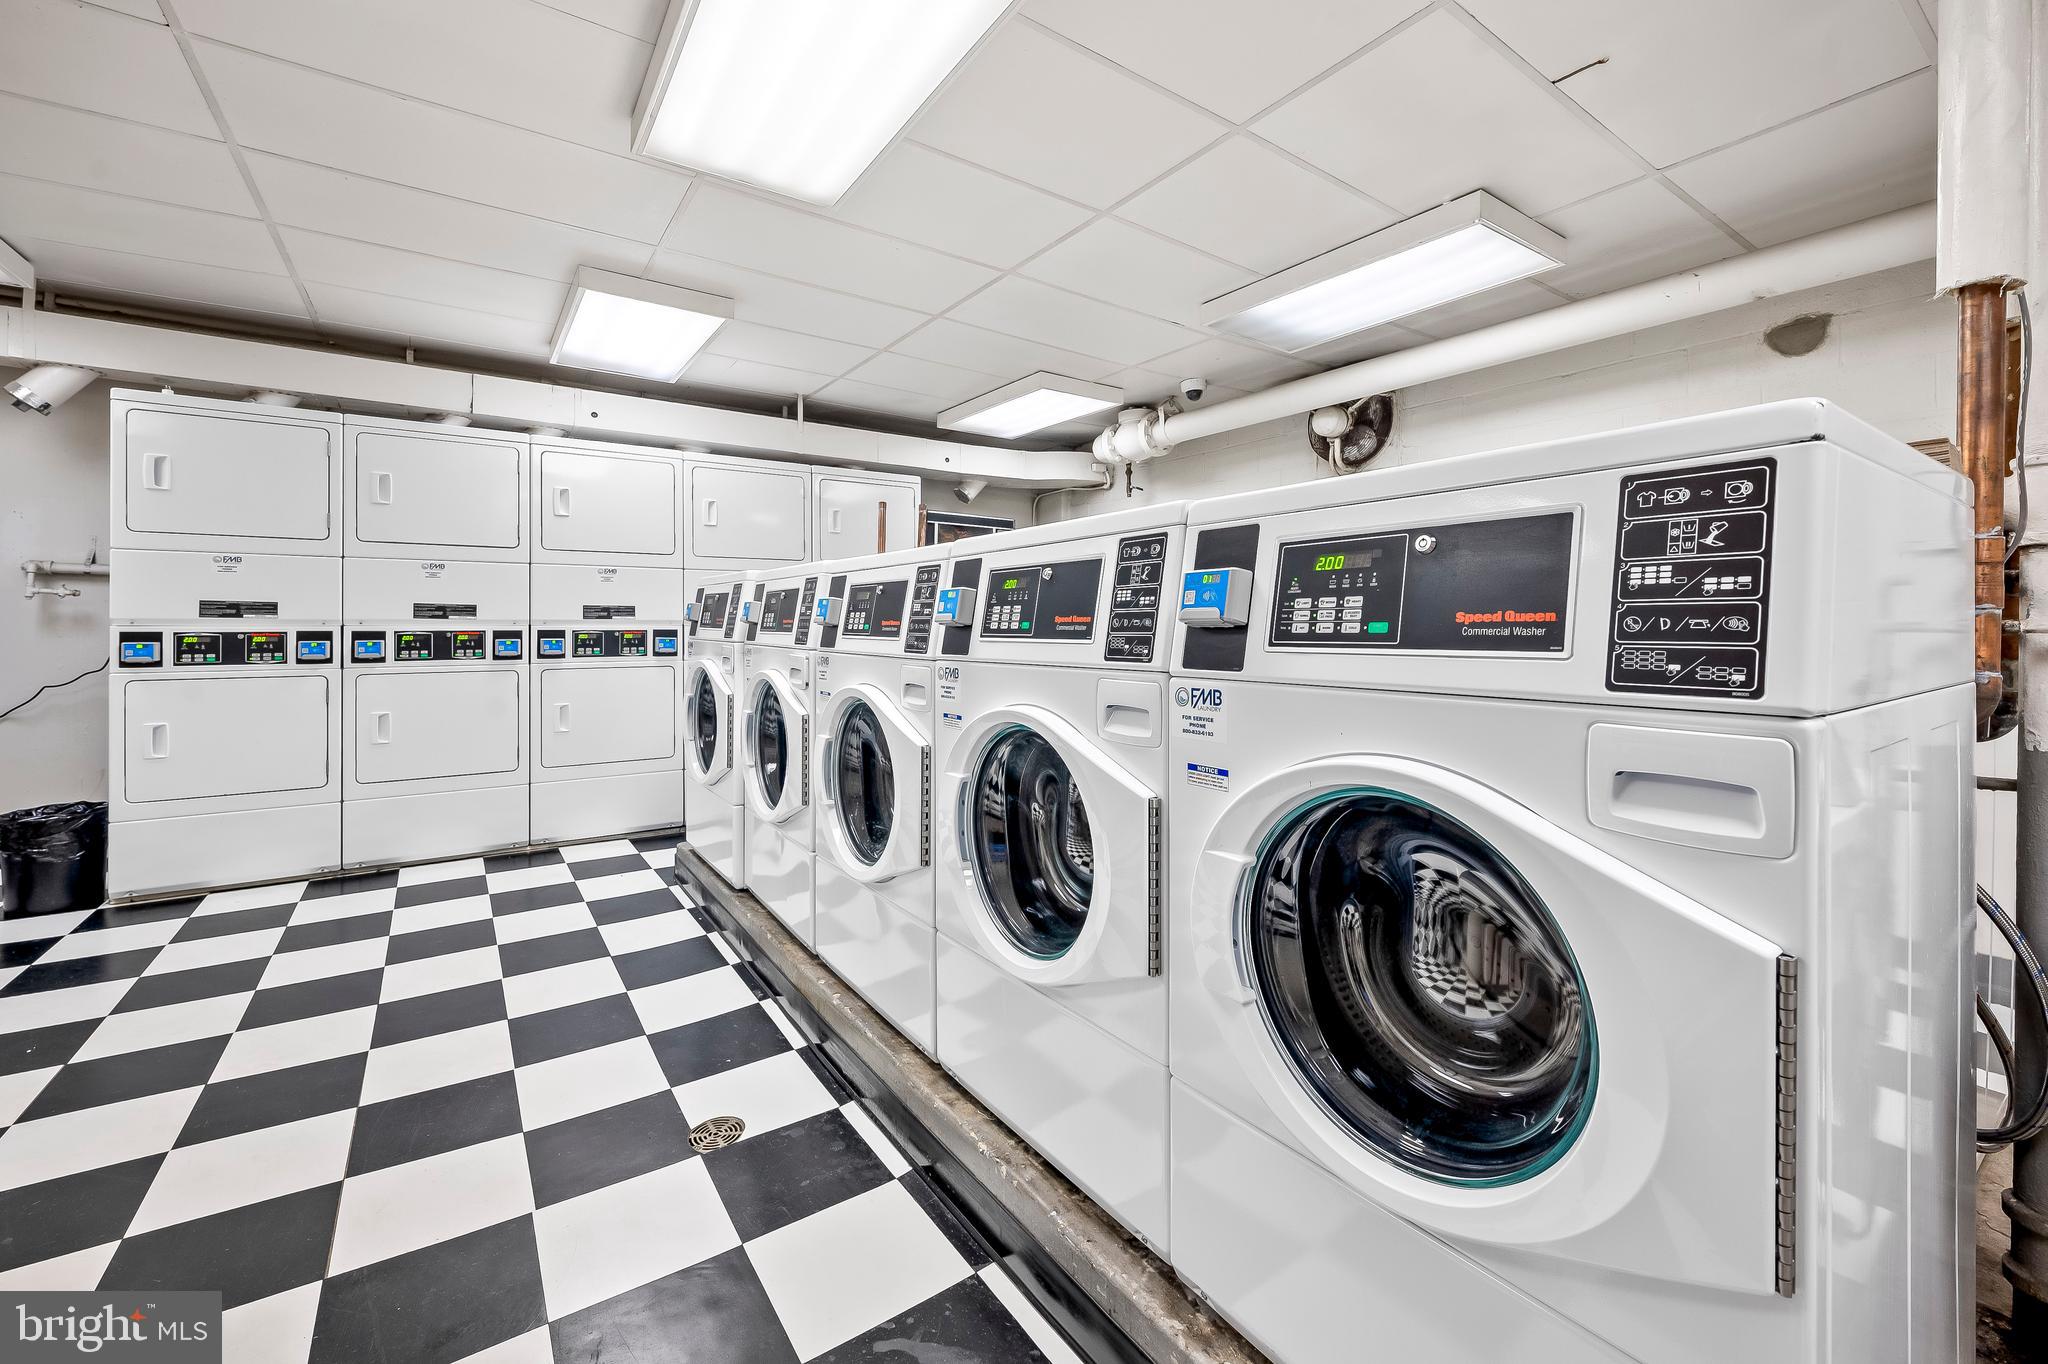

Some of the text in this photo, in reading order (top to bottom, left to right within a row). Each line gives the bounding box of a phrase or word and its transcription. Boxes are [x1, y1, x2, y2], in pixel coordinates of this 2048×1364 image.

[1455, 610, 1557, 625] Speed Queen
[1461, 626, 1547, 636] Commercial Washer
[1191, 687, 1223, 709] FMB
[1192, 715, 1214, 723] SERVICE
[1197, 765, 1219, 775] NOTICE
